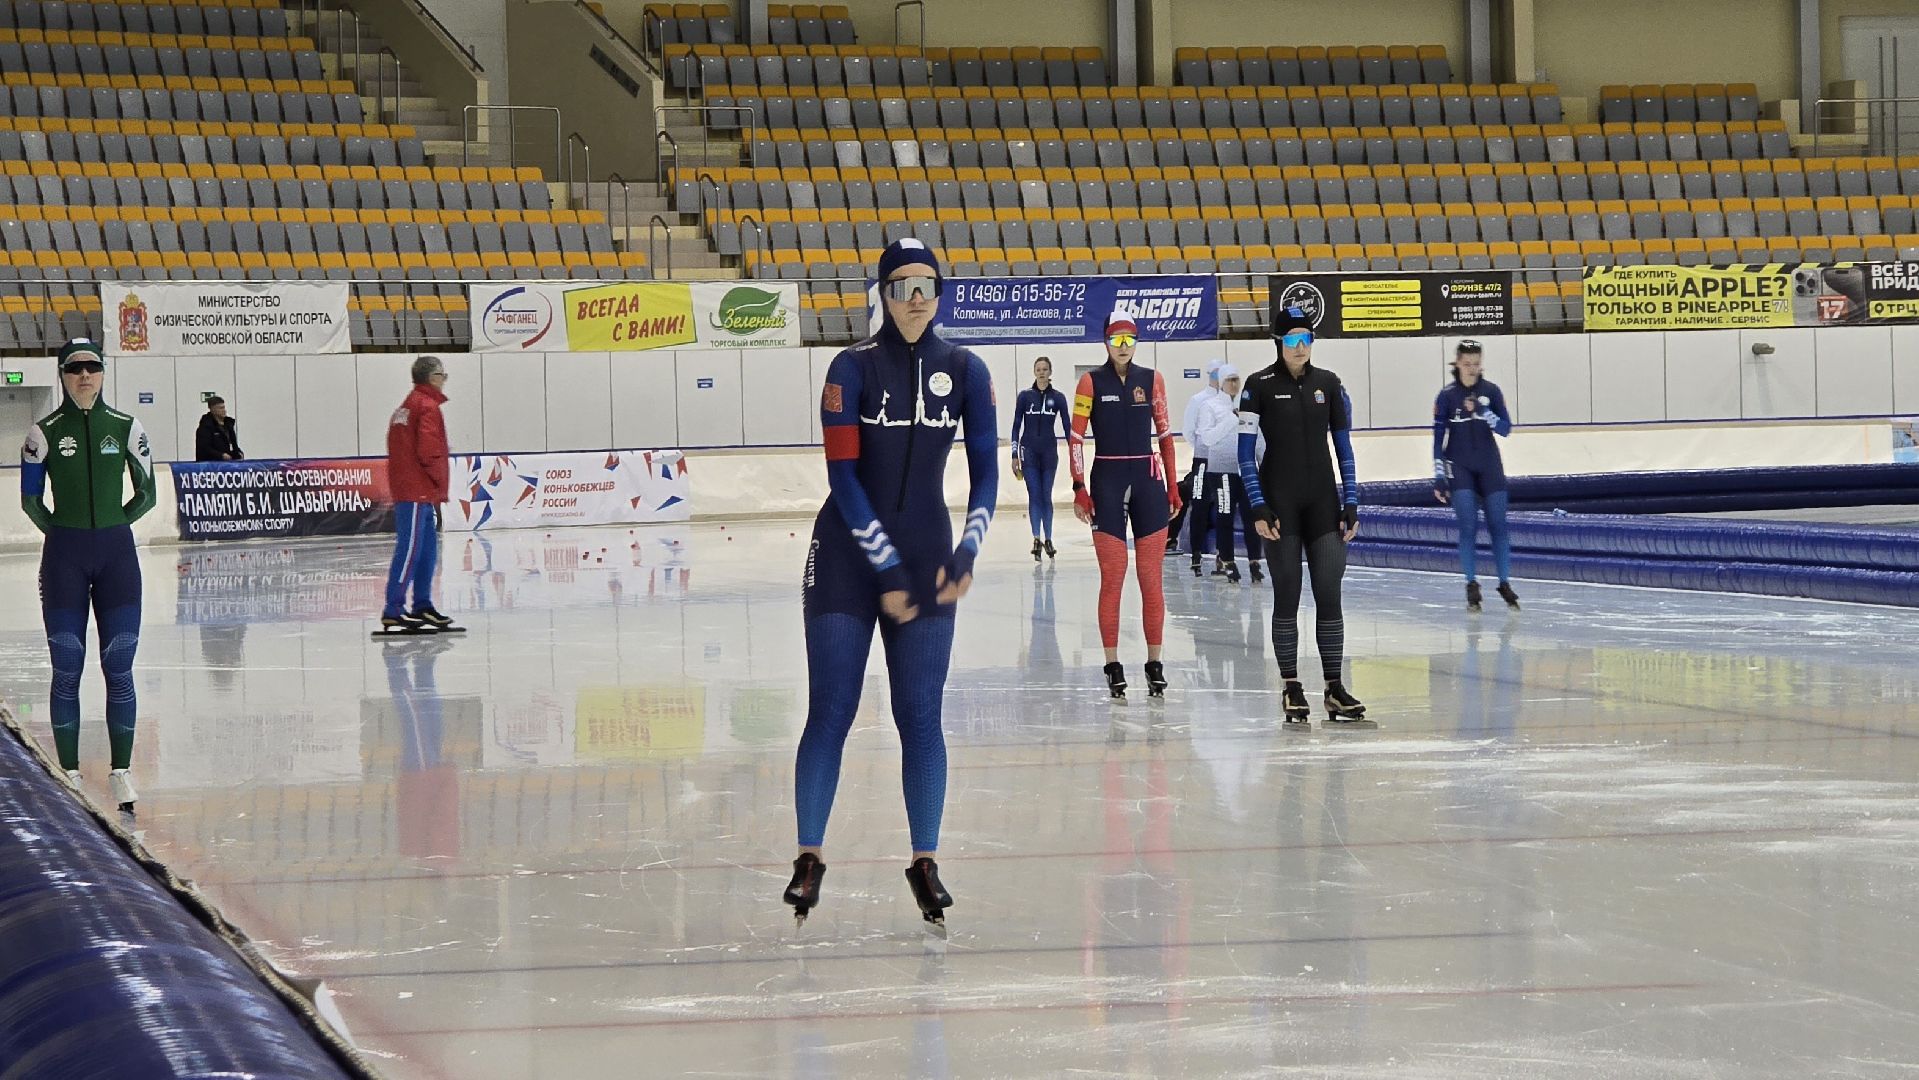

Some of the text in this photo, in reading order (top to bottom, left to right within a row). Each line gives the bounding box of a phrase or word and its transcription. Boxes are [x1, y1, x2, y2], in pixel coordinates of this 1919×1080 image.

[1614, 270, 1677, 280] ГДЕ КУПИТЬ
[1871, 261, 1919, 277] ВСЁ Р
[956, 283, 1086, 303] 8 (496) 615-56-72
[1451, 283, 1502, 292] ФРУНЗЕ 47/2
[1587, 276, 1788, 299] МОЩНЫЙ APPLE?
[198, 295, 281, 308] МИНИСТЕРСТВО
[577, 293, 639, 321] ВСЕГДА
[1114, 297, 1202, 319] ВЫСОТА
[1587, 301, 1657, 315] ТОЛЬКО
[1662, 302, 1673, 314] В
[1677, 300, 1772, 314] PINEAPPLE
[1887, 303, 1918, 315] ТРЦ
[724, 307, 787, 329] Зеленый
[953, 304, 1084, 322] Коломна, ул. Астахова, д. 2
[1820, 301, 1846, 319] 17
[154, 312, 333, 327] ФИЗИЧЕСКОЙ КУЛЬТУРЫ И СПОРТА
[1615, 315, 1770, 325] ГАРАНТИЯ НАЛИЧИЕ СЕРВИС
[612, 314, 686, 342] С ВАМИ!
[1147, 319, 1197, 339] медиа
[182, 330, 303, 345] МОСКОВСКОЙ ОБЛАСТИ
[710, 339, 787, 348] ТОРГОВЫЙ КОМПЛЕКС
[179, 468, 372, 489] XI ВСЕРОССИЙСКИЕ СОРЕВНОВАНИЯ
[545, 469, 572, 480] СОЮЗ
[543, 481, 615, 494] КОНЬКОБЕЖЦЕВ
[245, 491, 275, 515] Б.И.
[280, 489, 372, 515] ШАВЫРИНА»
[542, 497, 577, 508] РОССИИ
[200, 519, 264, 533] КОНЬКОБЕЖНОМУ
[264, 517, 294, 531] СПОРТУ
